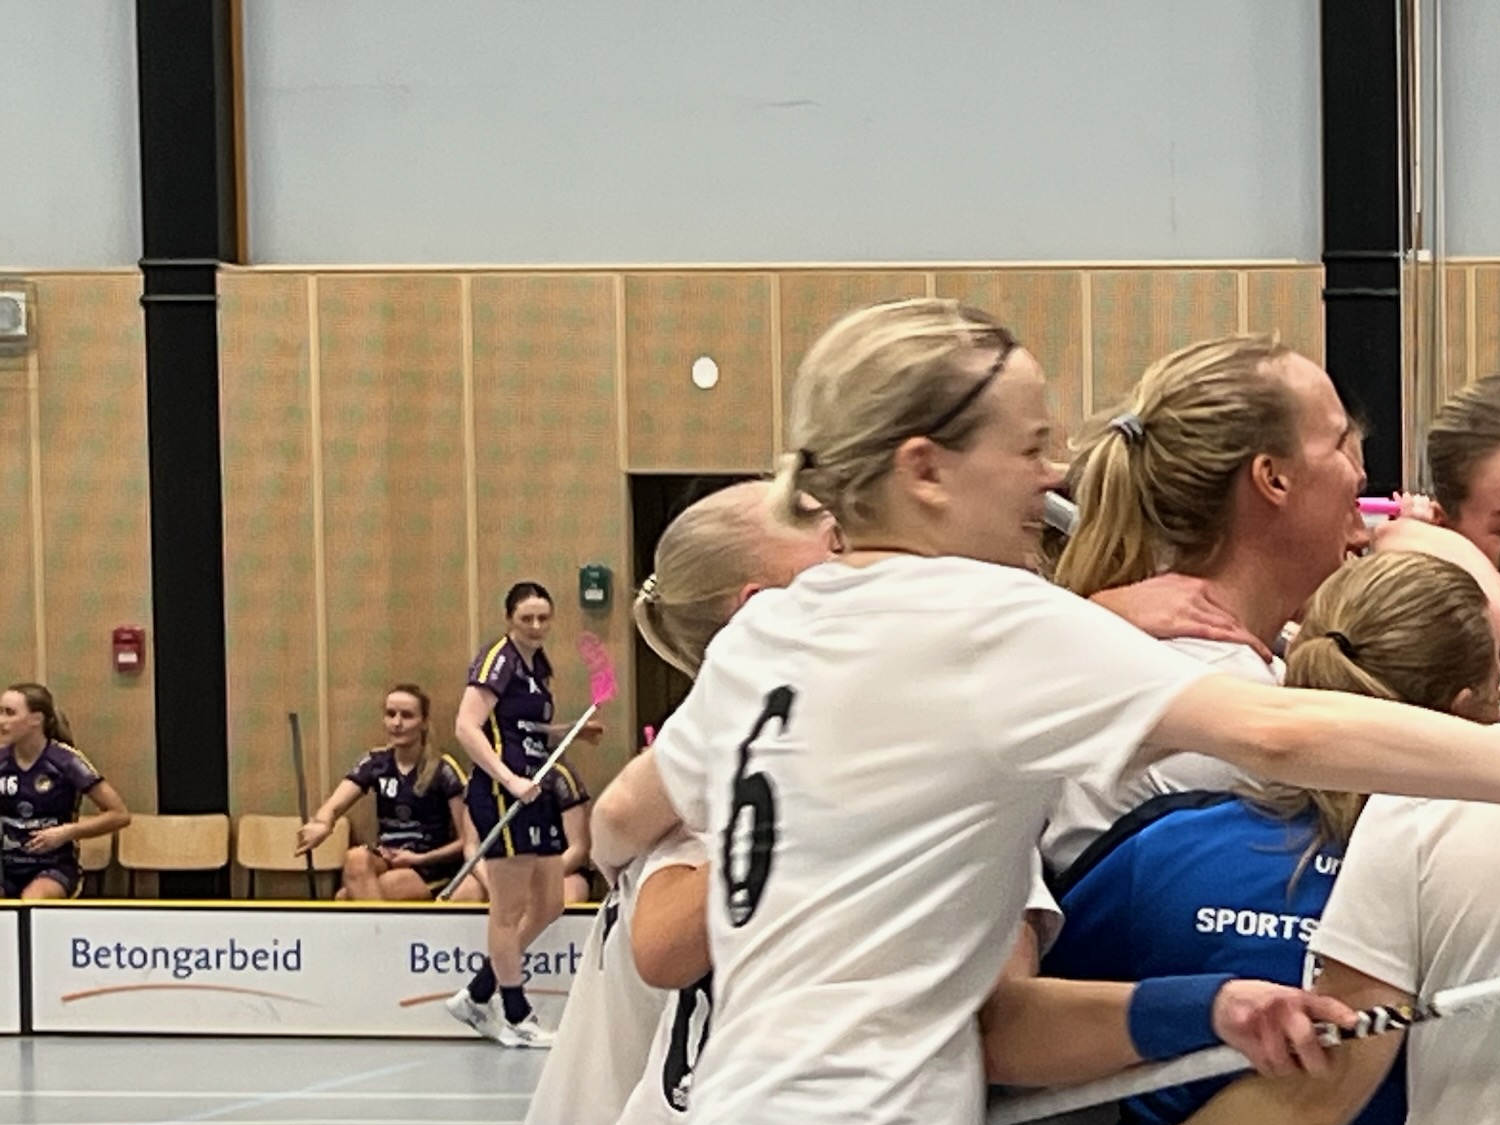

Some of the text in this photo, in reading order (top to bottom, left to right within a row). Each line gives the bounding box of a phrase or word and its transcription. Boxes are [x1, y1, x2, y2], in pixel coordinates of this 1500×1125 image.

[725, 684, 796, 928] 6
[1196, 907, 1320, 942] SPORTS
[71, 938, 302, 980] Betongarbeid
